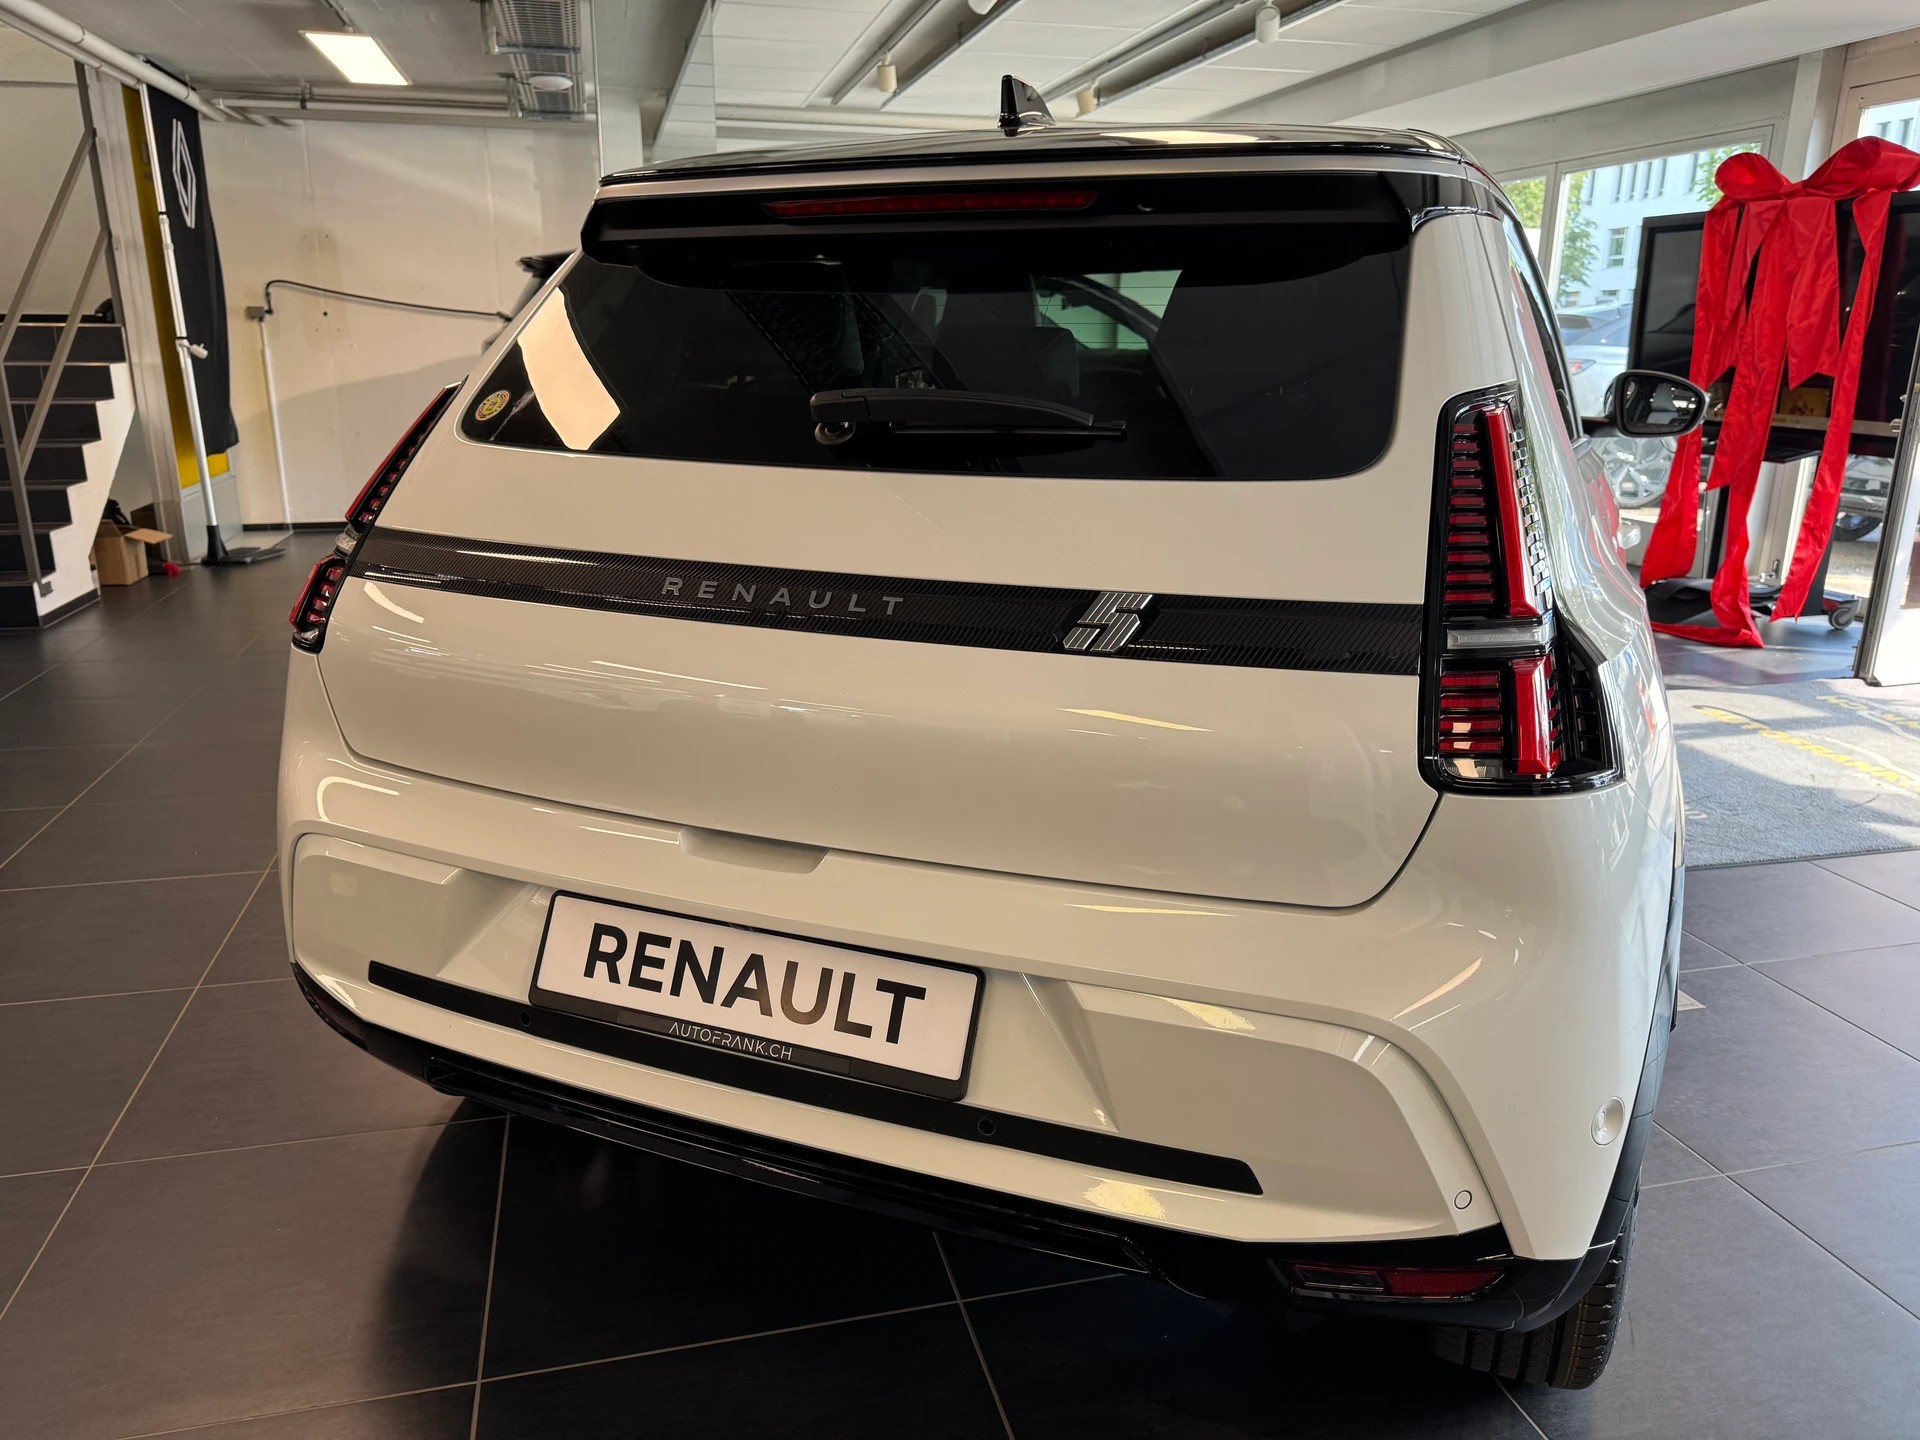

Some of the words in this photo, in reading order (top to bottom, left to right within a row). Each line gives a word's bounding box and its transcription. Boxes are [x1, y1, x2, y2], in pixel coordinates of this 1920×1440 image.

[661, 577, 904, 616] RENAULT
[1062, 591, 1154, 653] 5
[583, 922, 927, 1045] RENAULT
[668, 1021, 793, 1060] AUTOFRANK.CH
